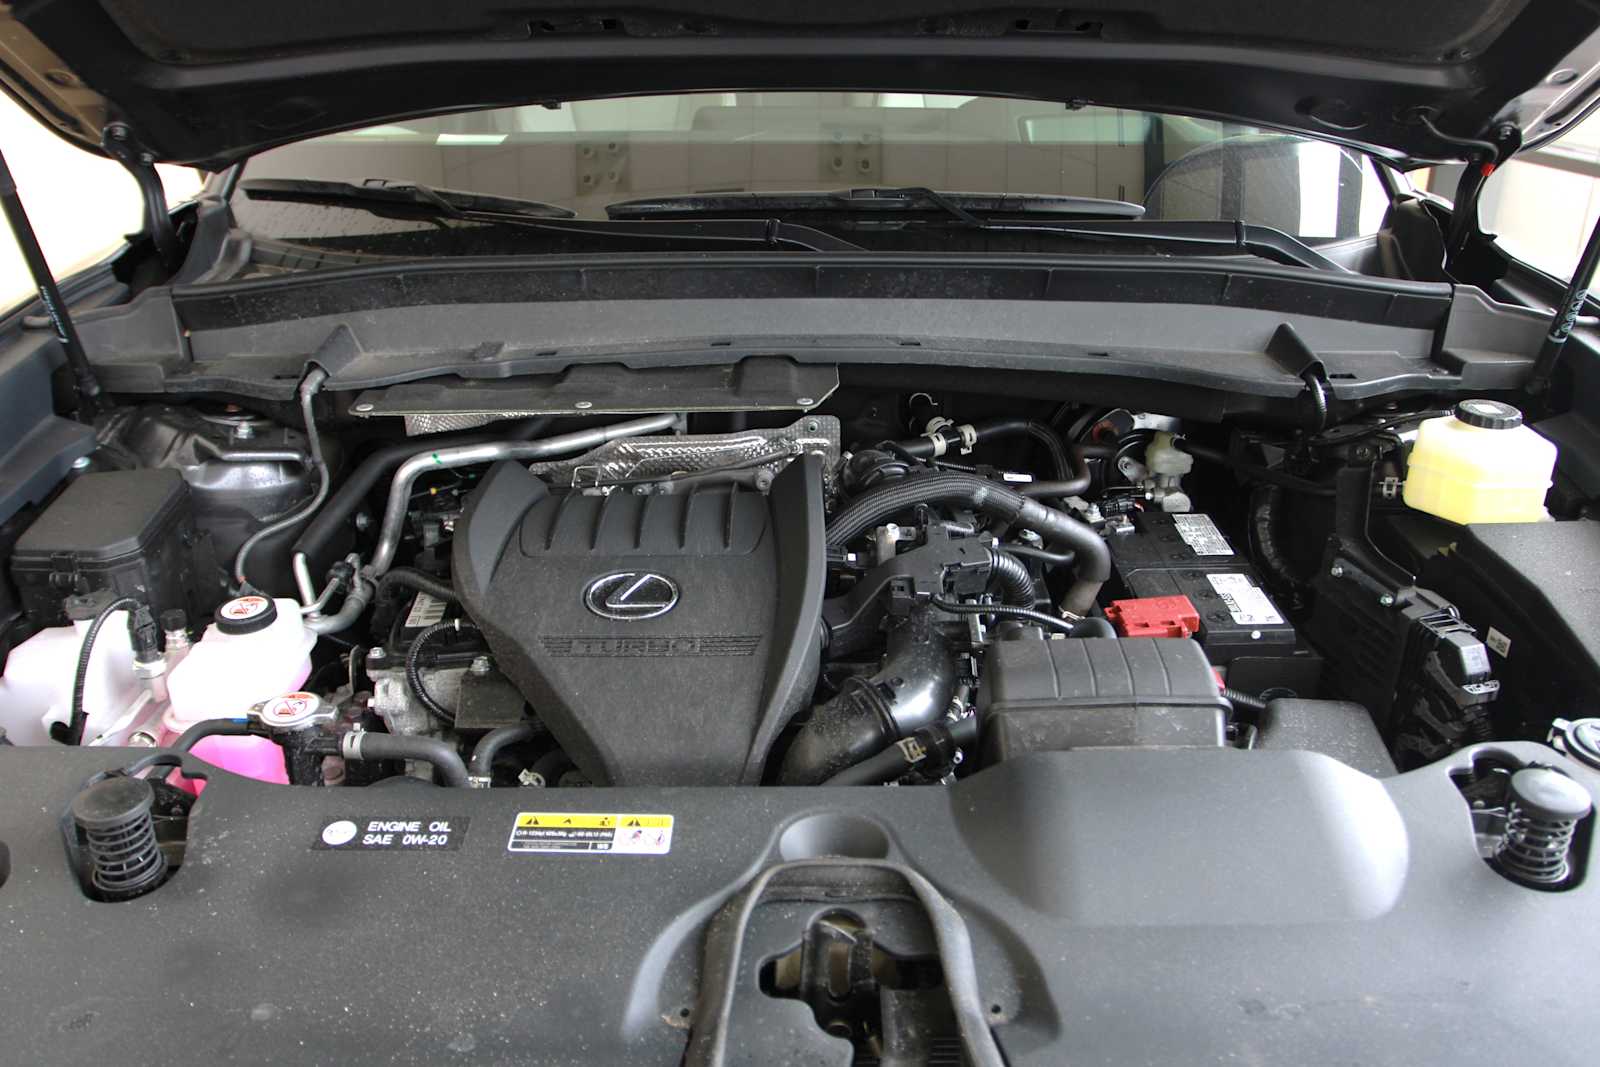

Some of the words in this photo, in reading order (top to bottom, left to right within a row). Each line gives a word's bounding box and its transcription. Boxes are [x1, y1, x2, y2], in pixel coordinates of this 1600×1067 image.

[571, 637, 702, 655] TURBO
[367, 821, 422, 832] ENGINE
[428, 821, 452, 833] OIL
[362, 834, 394, 845] SAE
[402, 834, 448, 846] 0W-20
